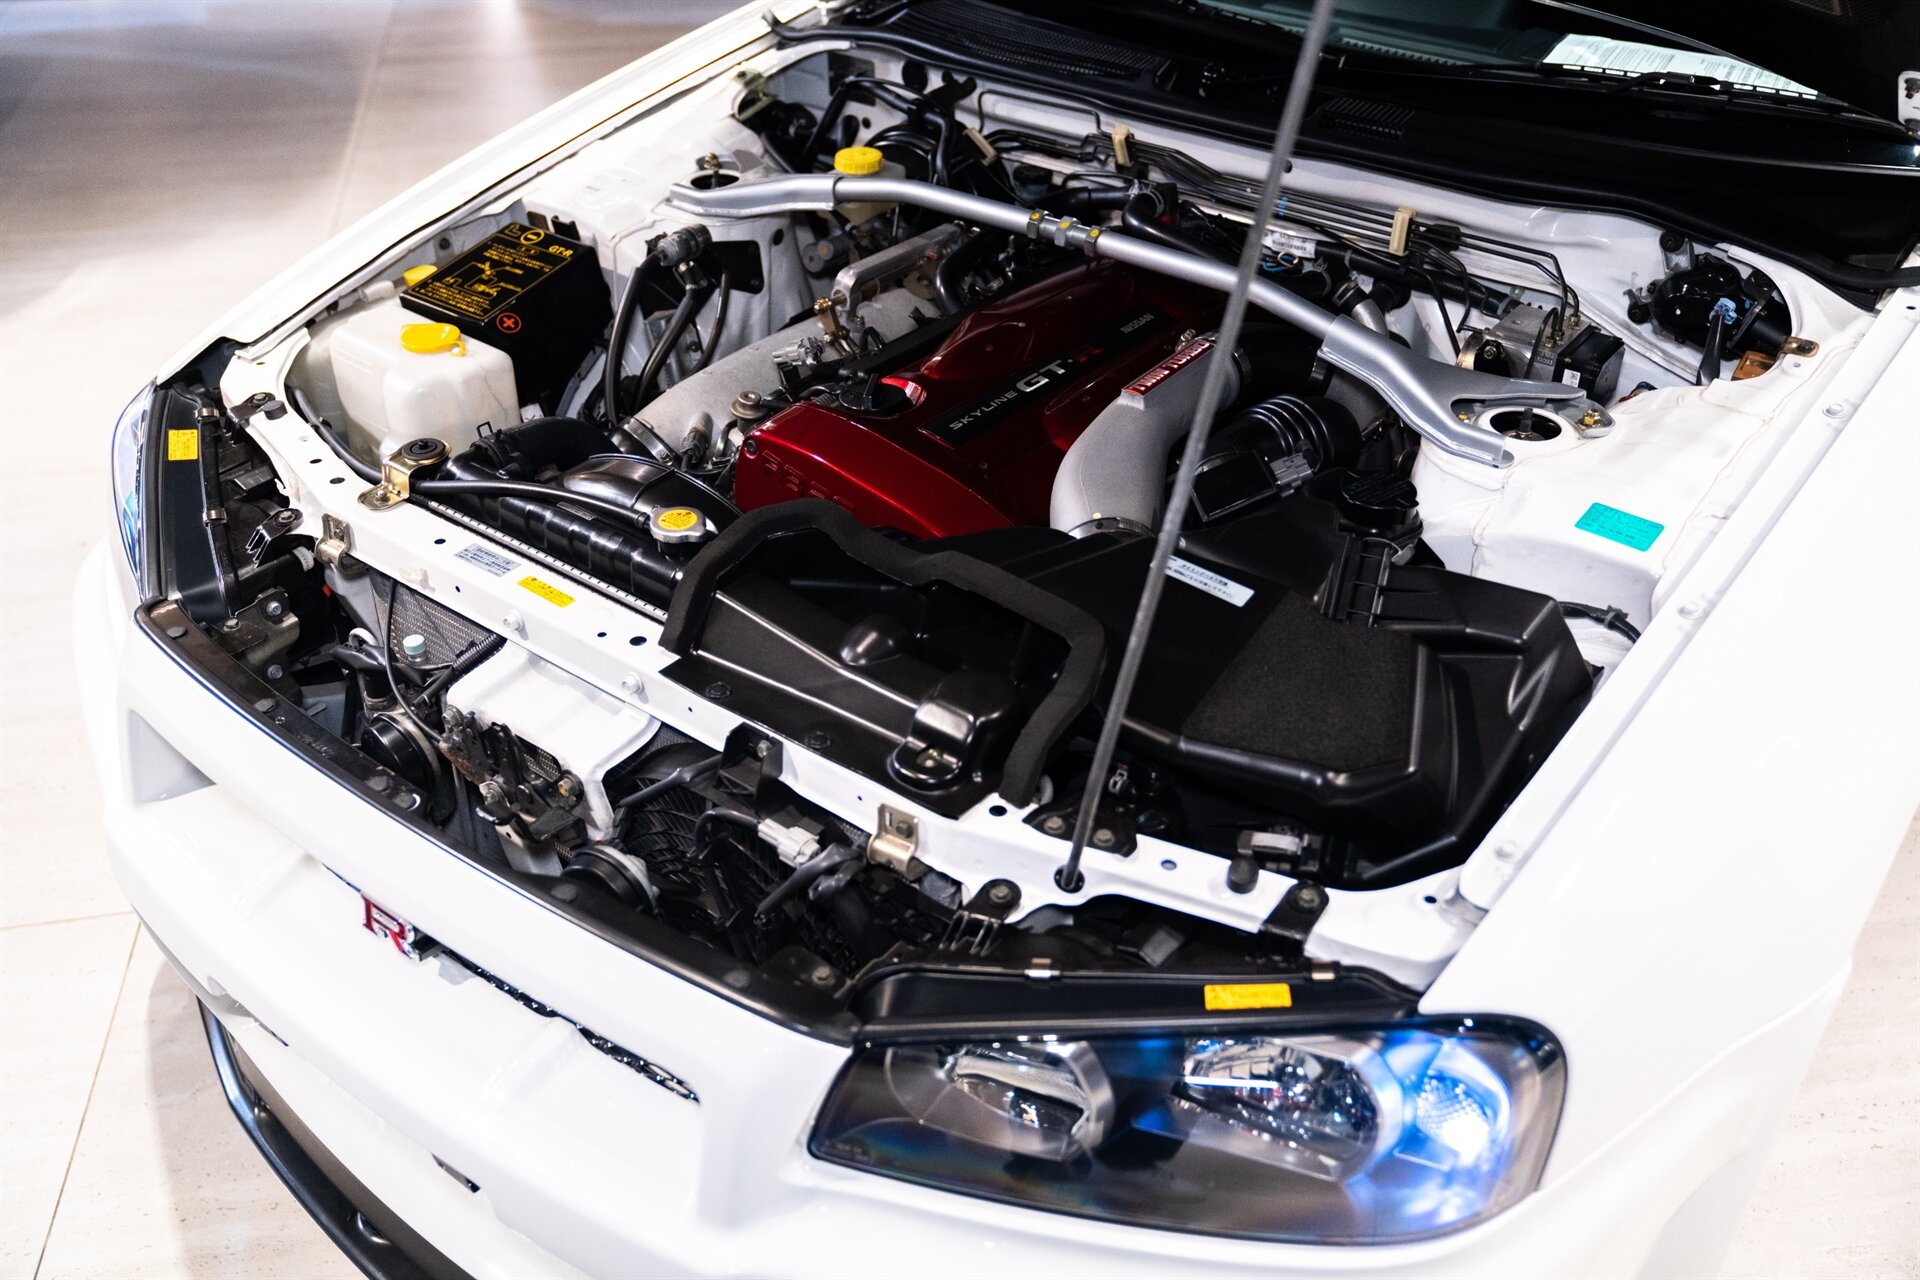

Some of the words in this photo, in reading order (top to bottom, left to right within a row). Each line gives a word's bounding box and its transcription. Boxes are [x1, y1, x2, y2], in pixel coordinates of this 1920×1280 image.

[1120, 313, 1155, 334] NISSAN
[1129, 367, 1170, 391] TWIN
[1163, 342, 1210, 369] TURBO
[949, 390, 1018, 430] SKYLINE
